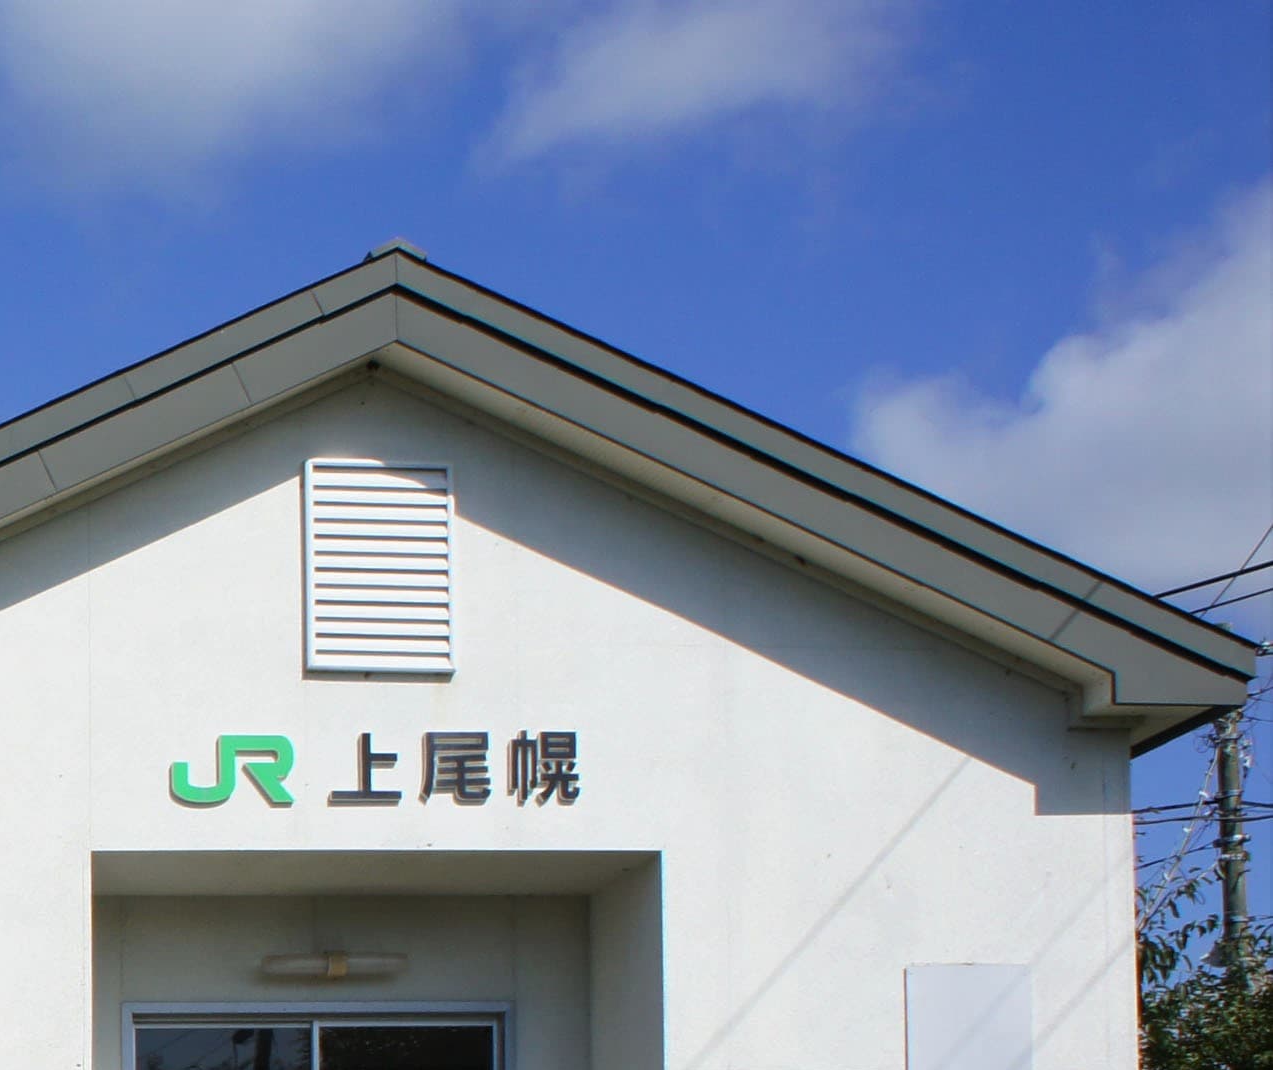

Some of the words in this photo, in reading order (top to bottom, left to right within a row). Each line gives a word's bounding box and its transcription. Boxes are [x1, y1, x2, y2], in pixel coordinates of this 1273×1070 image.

[170, 734, 294, 806] JR
[327, 730, 581, 807] 上尾幌
